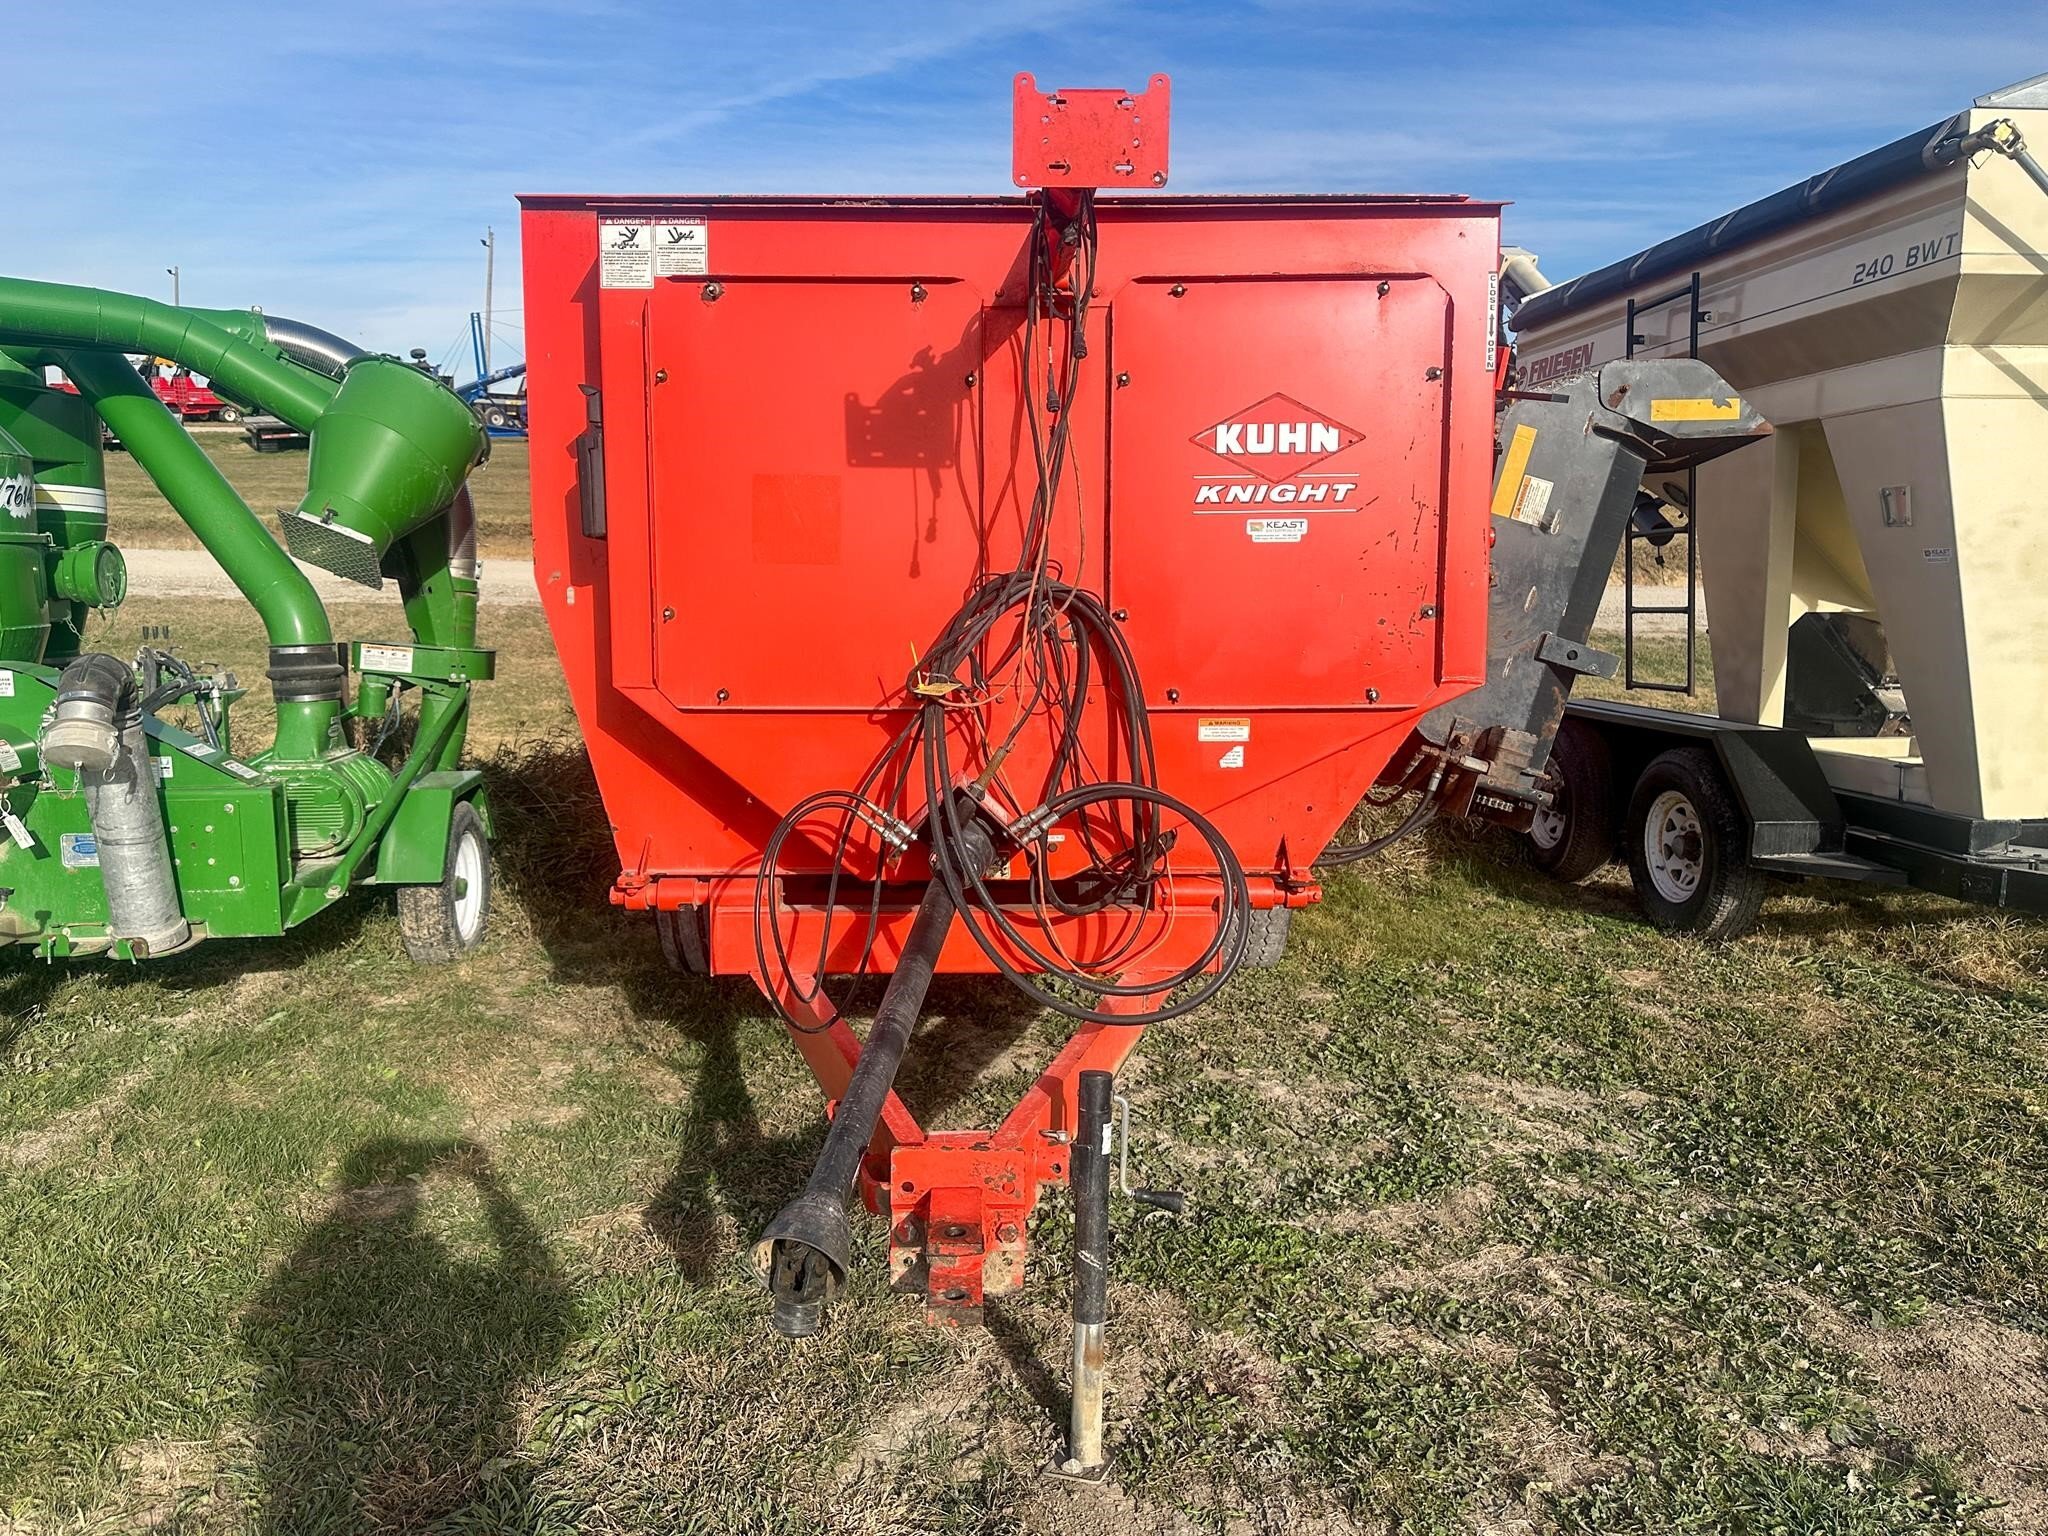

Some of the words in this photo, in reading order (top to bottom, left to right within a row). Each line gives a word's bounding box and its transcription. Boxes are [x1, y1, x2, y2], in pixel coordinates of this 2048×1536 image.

[613, 217, 646, 225] DANGER
[668, 217, 701, 225] DANGER
[1853, 254, 1894, 284] 240
[1906, 232, 1959, 268] BWT
[1486, 340, 1495, 368] OPEN
[1529, 341, 1594, 384] FRIESEN
[1215, 422, 1341, 454] KUHN
[1193, 483, 1358, 504] KNIGHT
[1266, 521, 1305, 529] KEAST
